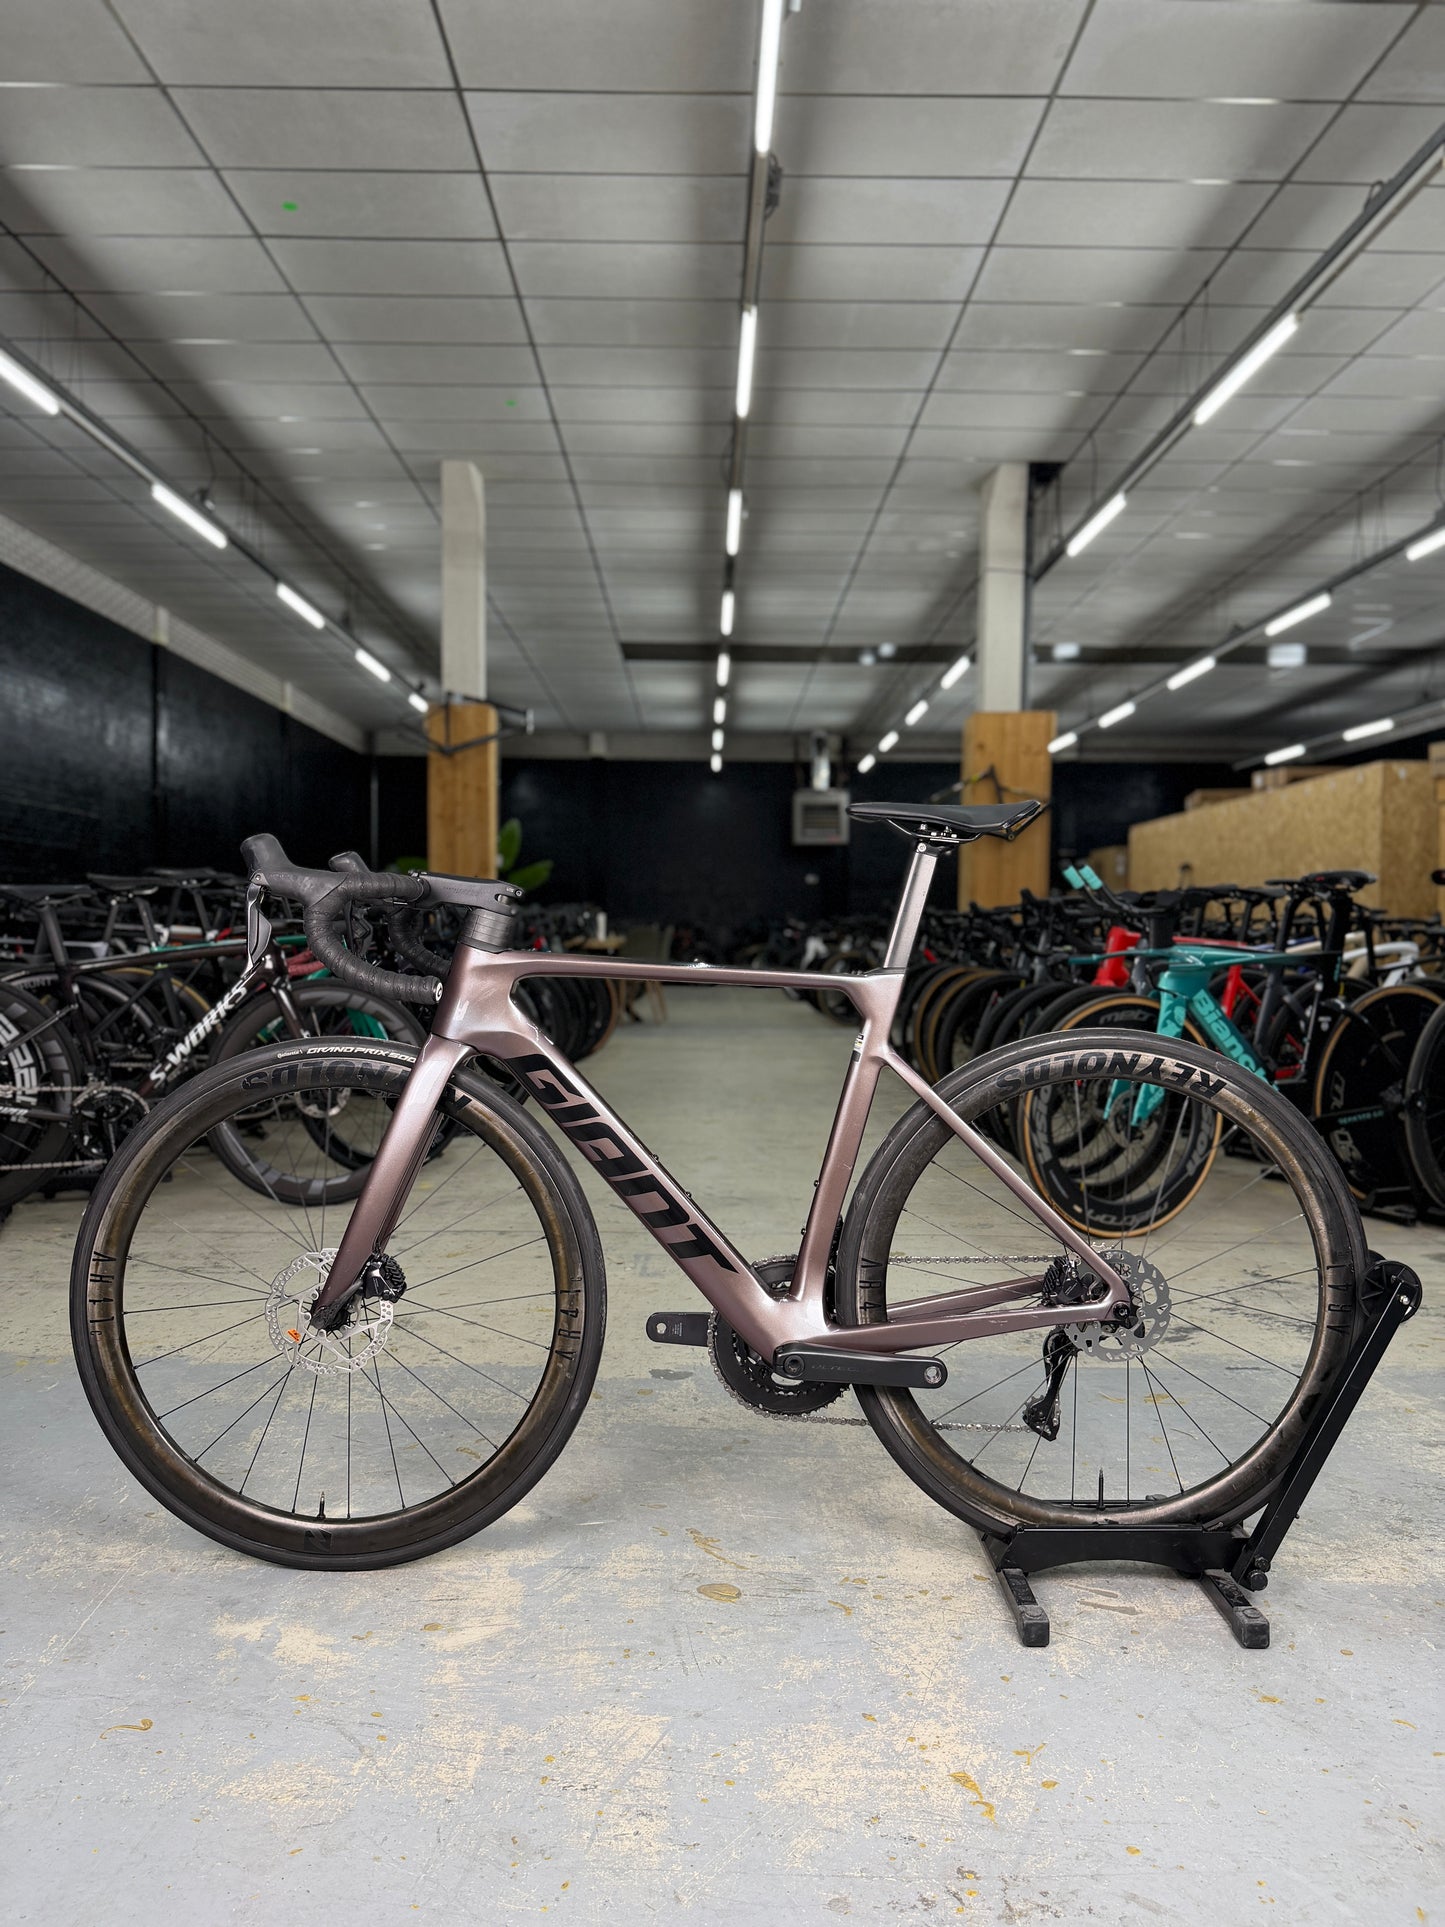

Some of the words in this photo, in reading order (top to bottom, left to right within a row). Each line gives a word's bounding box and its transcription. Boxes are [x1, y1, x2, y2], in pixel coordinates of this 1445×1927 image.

[149, 980, 248, 1089] S-WORKS
[307, 1046, 354, 1055] GRAND
[354, 1046, 387, 1057] PRIX
[387, 1052, 417, 1064] 500
[1192, 989, 1280, 1091] Bianc
[996, 1051, 1227, 1100] REYNOLDS
[503, 1053, 740, 1274] GIANT
[859, 1257, 883, 1312] AR4
